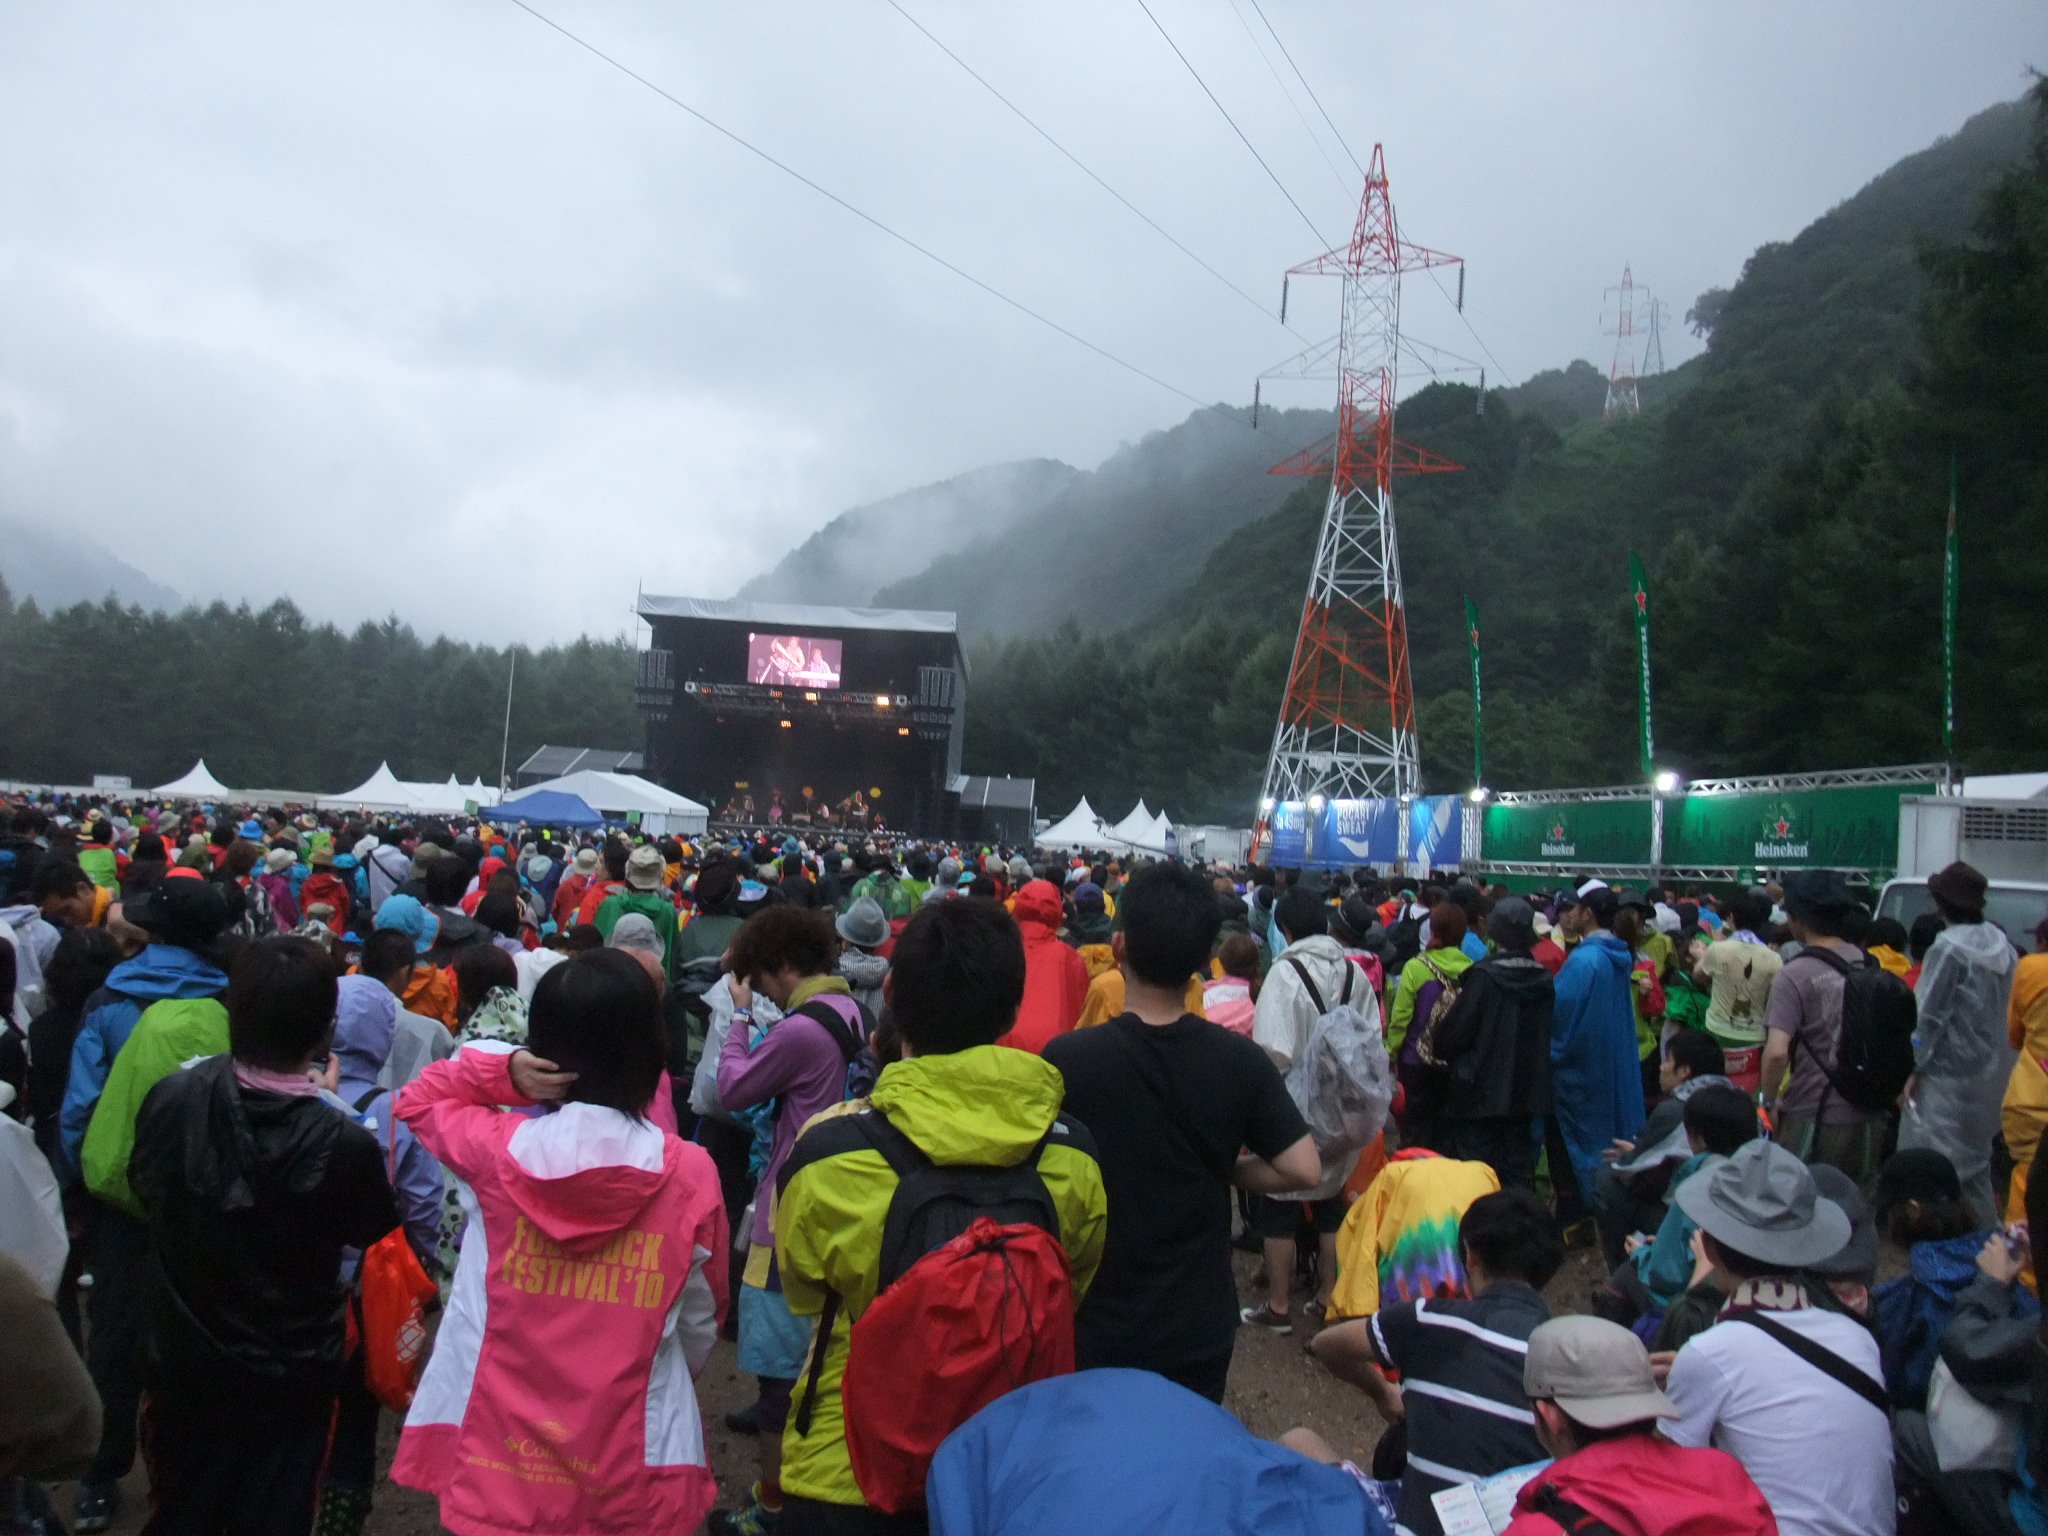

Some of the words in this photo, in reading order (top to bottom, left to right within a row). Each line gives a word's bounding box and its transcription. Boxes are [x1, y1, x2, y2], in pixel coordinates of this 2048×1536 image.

[1337, 820, 1366, 835] SWEAT
[1541, 843, 1575, 856] Heineken
[1754, 842, 1808, 858] Heineken
[584, 1229, 664, 1271] OCK
